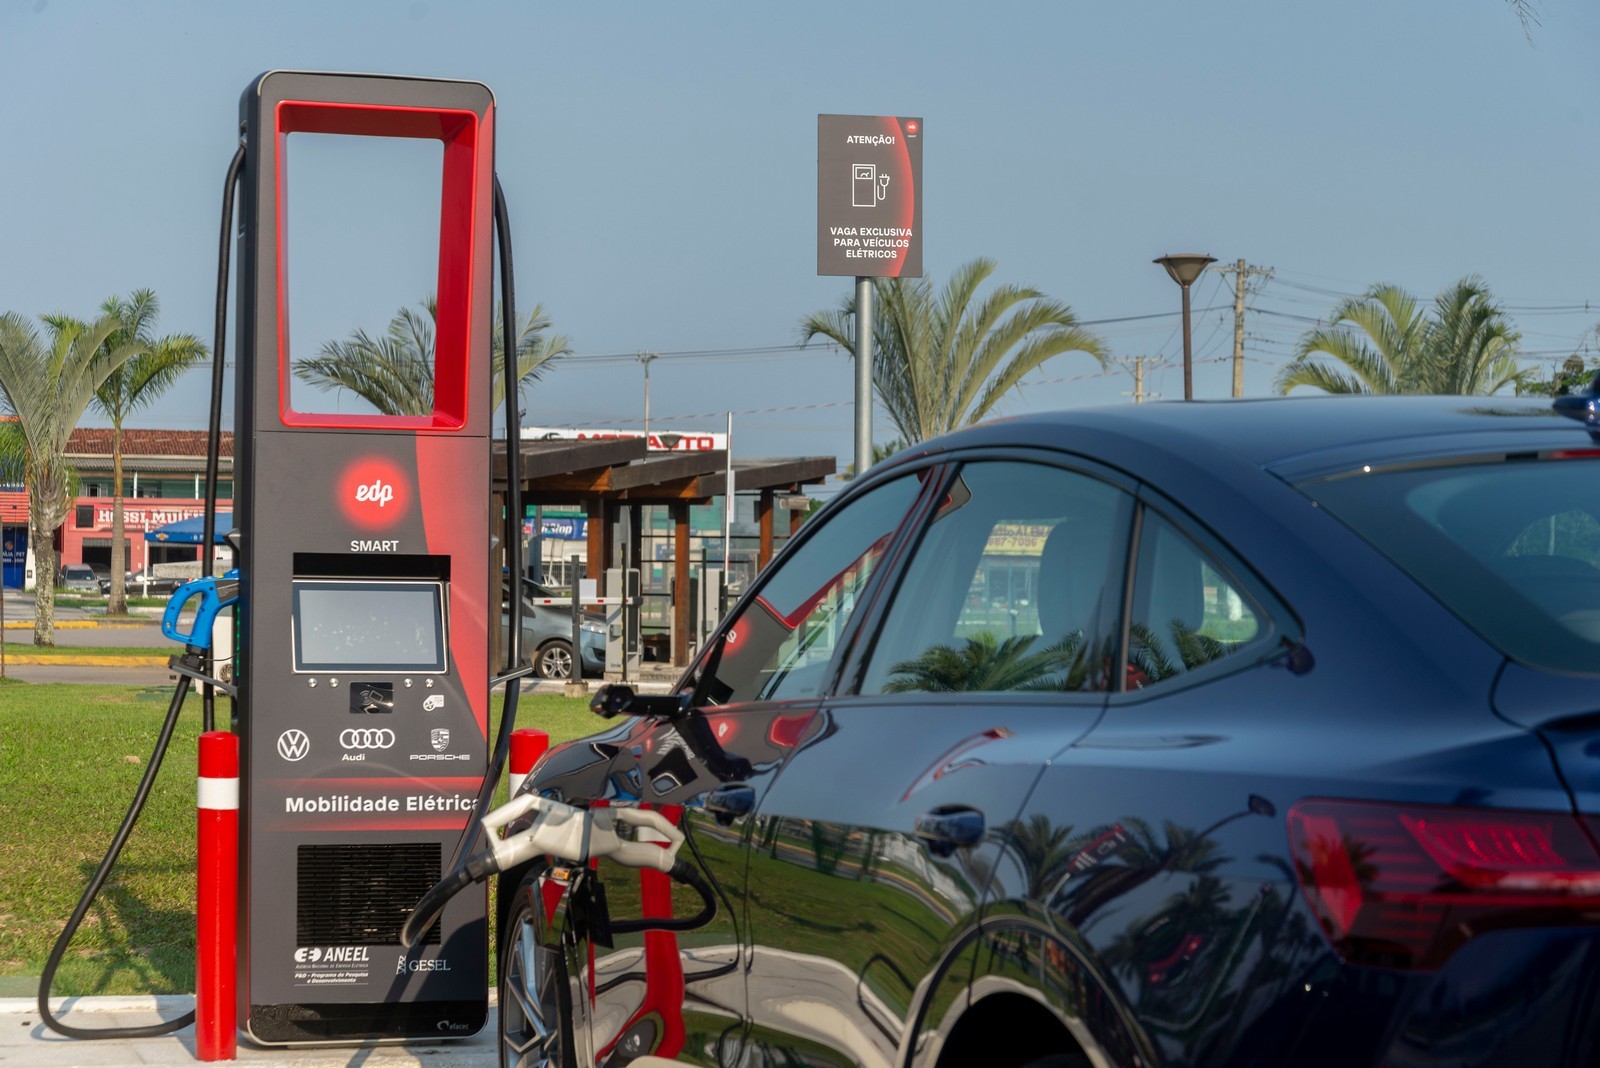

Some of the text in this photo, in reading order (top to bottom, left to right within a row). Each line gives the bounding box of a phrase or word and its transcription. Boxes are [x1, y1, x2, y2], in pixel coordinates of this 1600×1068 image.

[846, 134, 896, 147] ATENÇÃO!
[830, 226, 913, 237] VAGA EXCLUSIVA
[833, 237, 910, 248] PARA VEÍCULOS
[846, 248, 897, 259] ELÉTRICOS
[355, 479, 394, 507] edp
[350, 540, 399, 552] SMART
[341, 753, 366, 761] Audi
[285, 795, 400, 813] Mobilidade
[323, 947, 369, 962] ANEEL
[408, 959, 451, 972] GESEL
